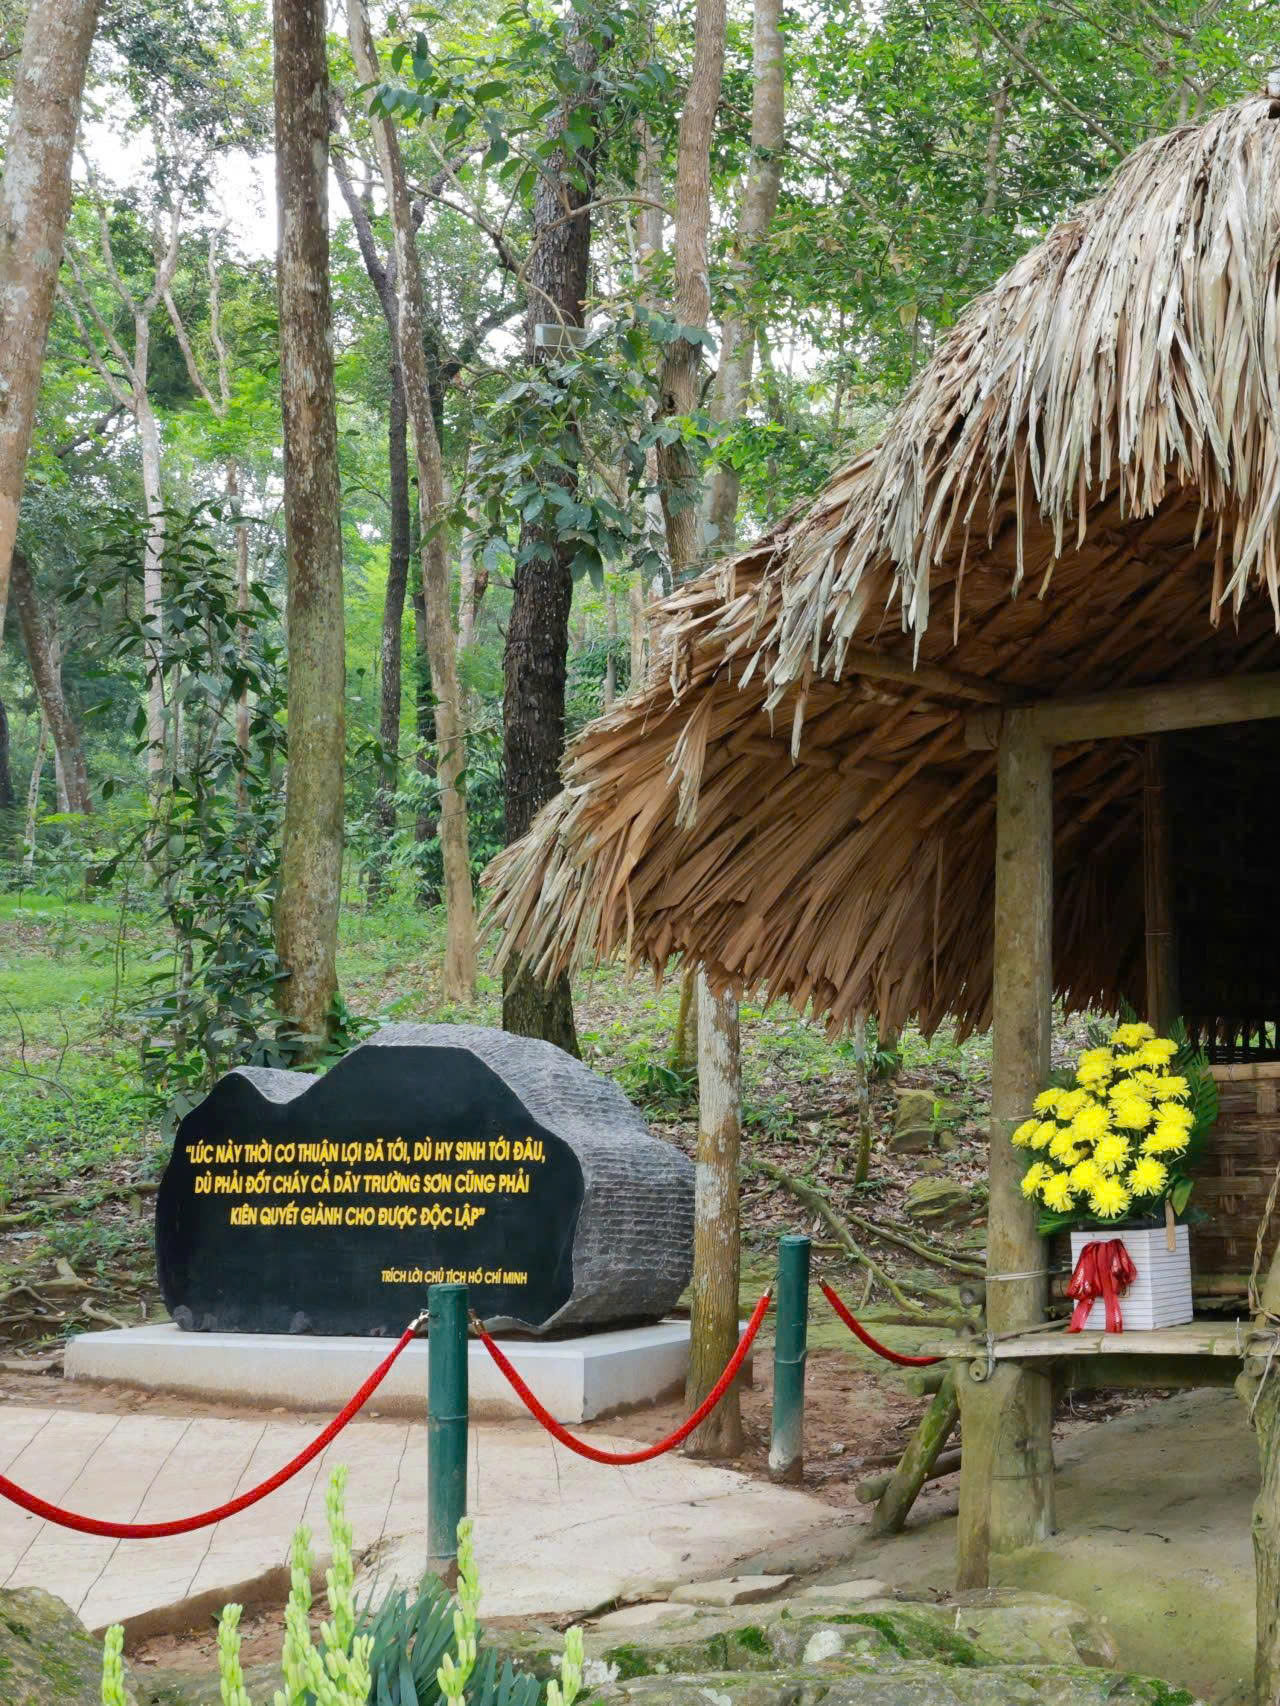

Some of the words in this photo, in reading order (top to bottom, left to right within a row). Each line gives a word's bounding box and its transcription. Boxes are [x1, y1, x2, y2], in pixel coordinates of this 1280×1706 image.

[215, 1138, 243, 1163] NÀY
[244, 1138, 272, 1163] THỜI
[274, 1142, 296, 1163] CƠ
[298, 1138, 339, 1167] THUẬN
[341, 1141, 362, 1167] LỢI
[364, 1138, 384, 1162] ĐÃ
[387, 1136, 411, 1164] TỚI,
[413, 1136, 431, 1162] DÙ
[435, 1141, 453, 1162] HY
[455, 1141, 486, 1162] SINH
[488, 1135, 510, 1162] TỚI
[194, 1169, 212, 1194] DÙ
[214, 1169, 243, 1194] PHẢI
[245, 1169, 271, 1194] ĐỐT
[273, 1169, 309, 1194] CHÁY
[311, 1168, 331, 1193] CẢ
[333, 1170, 361, 1193] DÃY
[363, 1170, 421, 1193] TRƯỜNG
[423, 1173, 452, 1193] SƠN
[455, 1169, 496, 1193] CŨNG
[498, 1167, 530, 1193] PHẢI
[230, 1202, 258, 1225] KIÊN
[260, 1200, 300, 1225] QUYẾT
[301, 1201, 343, 1226] GIÀNH
[345, 1207, 376, 1226] CHO
[378, 1205, 417, 1230] ĐƯỢC
[420, 1203, 452, 1230] ĐỘC
[381, 1267, 406, 1283] TRÍCH
[408, 1267, 422, 1283] LỜI
[484, 1268, 503, 1284] CHÍ
[503, 1271, 528, 1284] MINH
